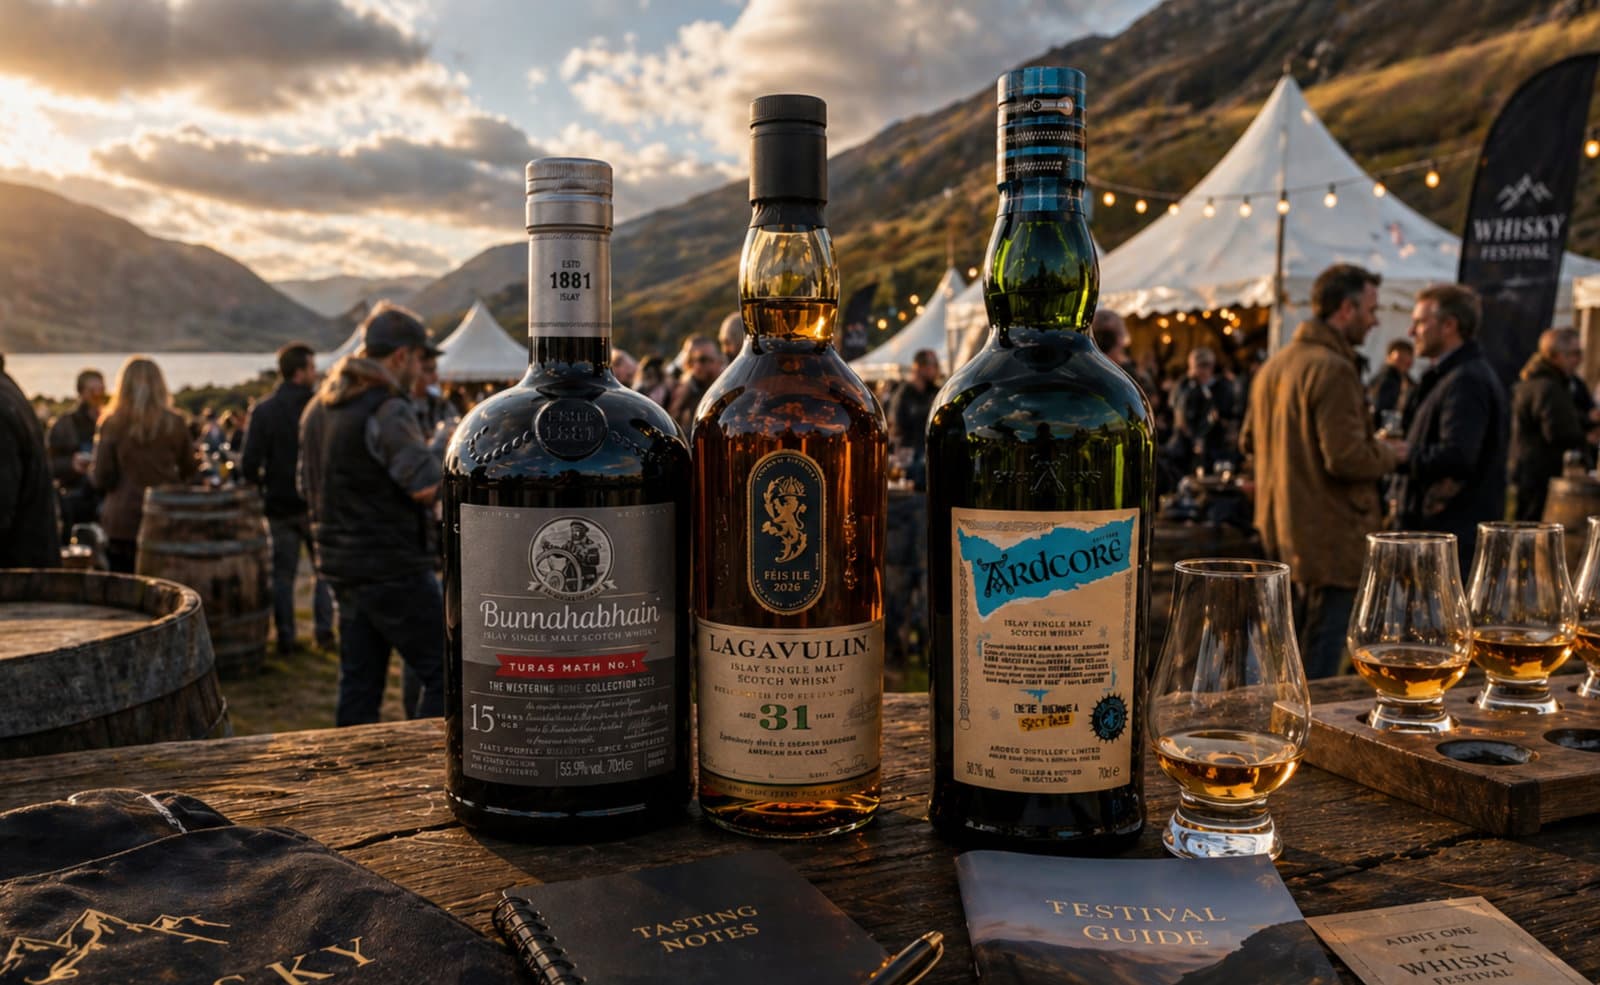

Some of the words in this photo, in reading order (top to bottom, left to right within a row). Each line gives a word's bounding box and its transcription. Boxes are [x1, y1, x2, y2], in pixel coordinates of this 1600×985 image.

[1473, 213, 1566, 241] WHISKY
[1480, 243, 1549, 260] FESTIVAL
[550, 271, 591, 289] 1881
[479, 600, 661, 630] Bunnahabhain
[511, 633, 548, 643] SINGLE
[551, 634, 580, 643] MALT
[581, 631, 622, 642] SCOTCH
[1011, 629, 1047, 637] SCOTCH
[509, 662, 555, 674] TURAS
[562, 663, 602, 673] MATH
[631, 659, 637, 669] 1
[731, 662, 760, 673] ISLAY
[765, 665, 809, 674] SINGLE
[815, 663, 844, 673] MALT
[489, 680, 503, 691] THE
[585, 679, 637, 693] COLLECTION
[737, 674, 784, 686] SCOTCH
[790, 675, 837, 686] WHISKY
[470, 703, 496, 733] 15
[759, 703, 812, 731] 31
[1046, 899, 1227, 923] FESTIVAL
[632, 905, 758, 939] TASTING
[660, 923, 759, 953] NOTES
[1083, 925, 1209, 945] GUIDE
[1440, 926, 1478, 938] ONE
[1398, 951, 1514, 976] WHISKY
[1433, 968, 1514, 985] FESTIVAL
